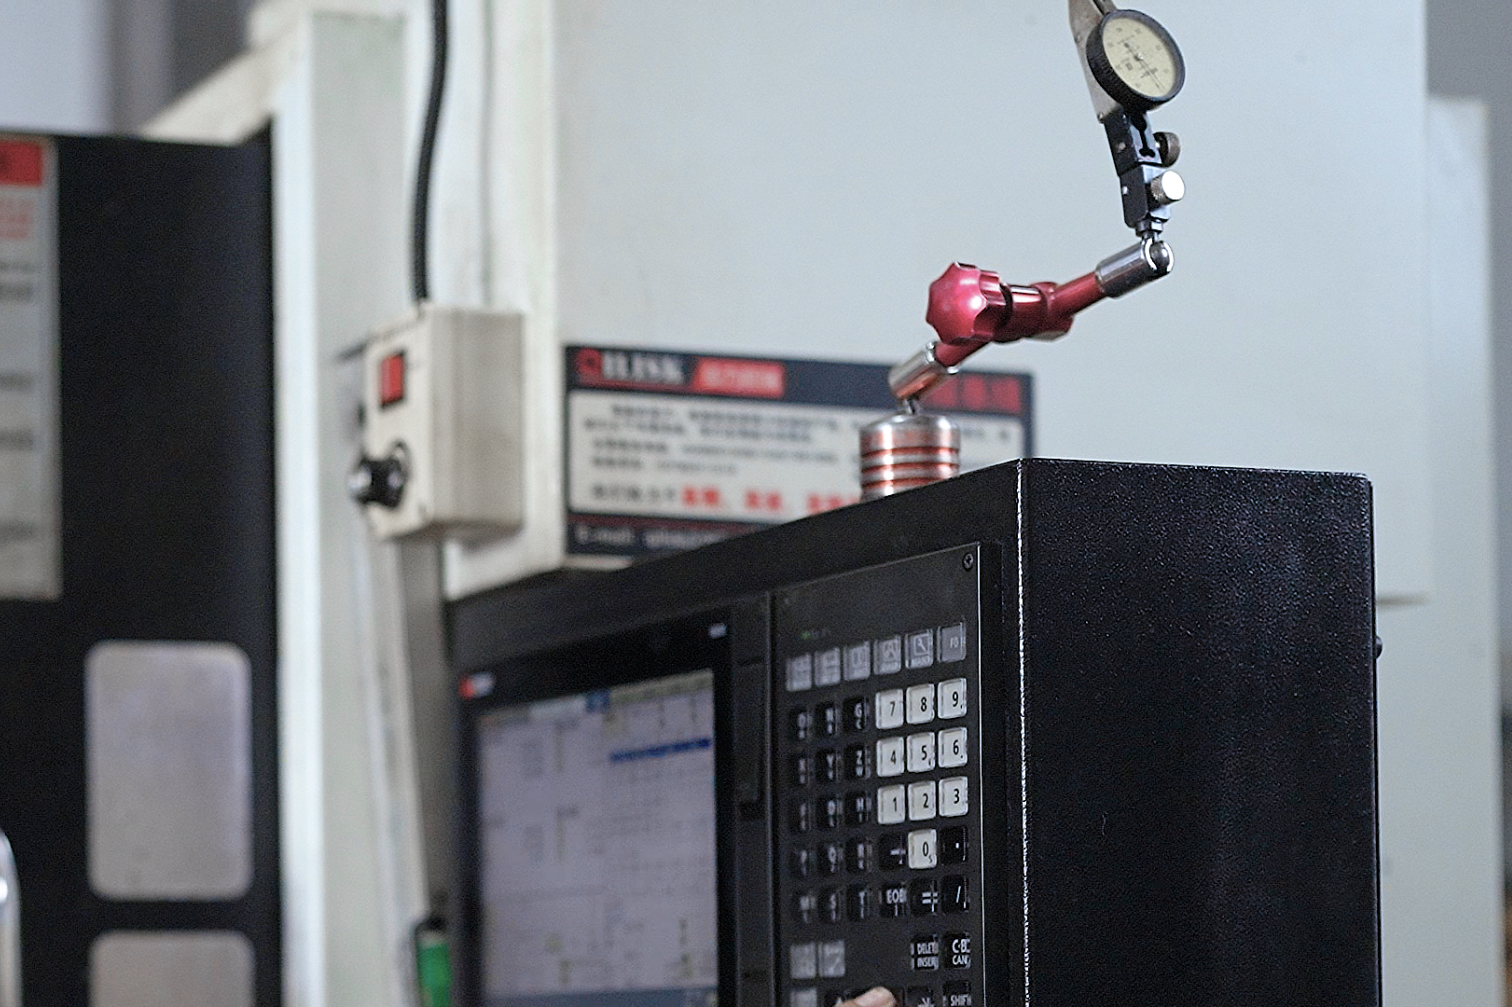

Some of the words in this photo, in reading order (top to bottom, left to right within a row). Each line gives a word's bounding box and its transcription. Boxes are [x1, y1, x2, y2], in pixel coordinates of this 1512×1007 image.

[920, 696, 928, 713] 8
[951, 691, 959, 708] 9
[854, 702, 862, 717] G
[889, 701, 897, 717] 7
[921, 744, 928, 761] 5
[952, 739, 960, 756] 6
[889, 749, 897, 766] 4
[892, 796, 898, 813] 1
[922, 792, 929, 809] 2
[953, 788, 960, 804] 3
[922, 841, 929, 857] 0
